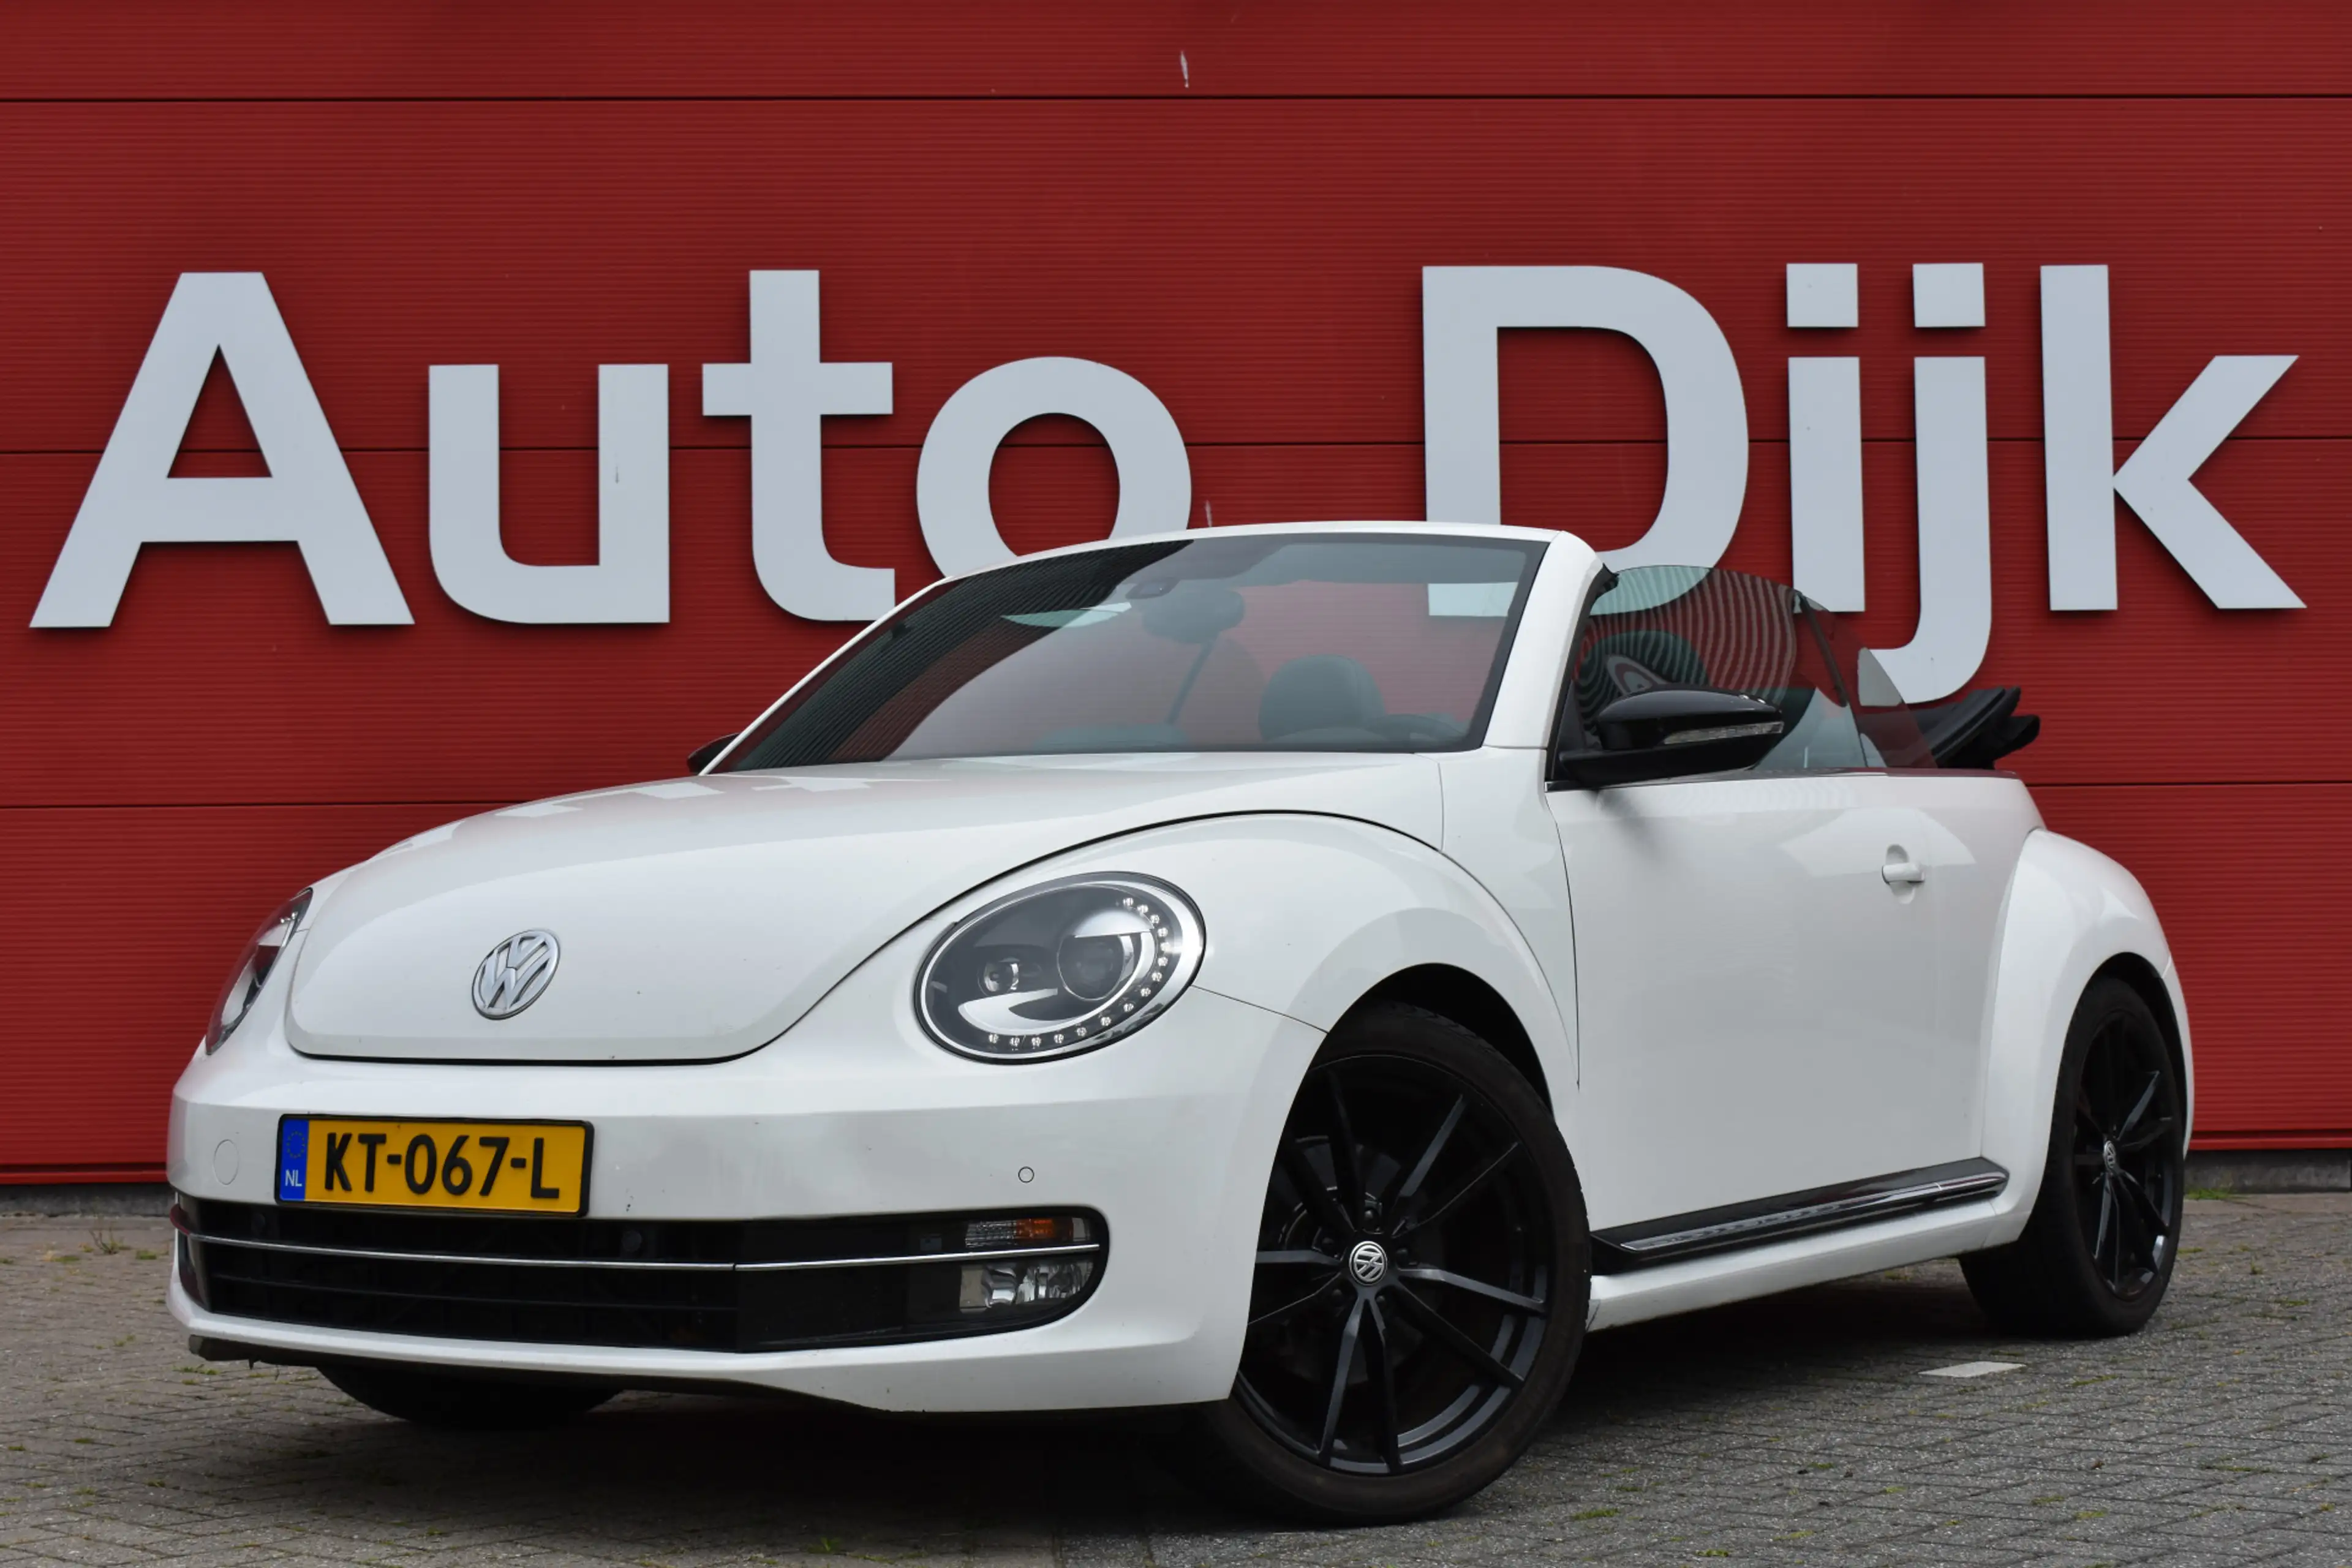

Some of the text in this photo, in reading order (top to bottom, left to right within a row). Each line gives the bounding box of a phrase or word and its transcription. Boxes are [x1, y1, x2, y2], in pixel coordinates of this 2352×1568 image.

[29, 262, 2307, 704] Auto Dijk
[285, 1169, 303, 1186] NL
[324, 1133, 560, 1199] KT-067-L
